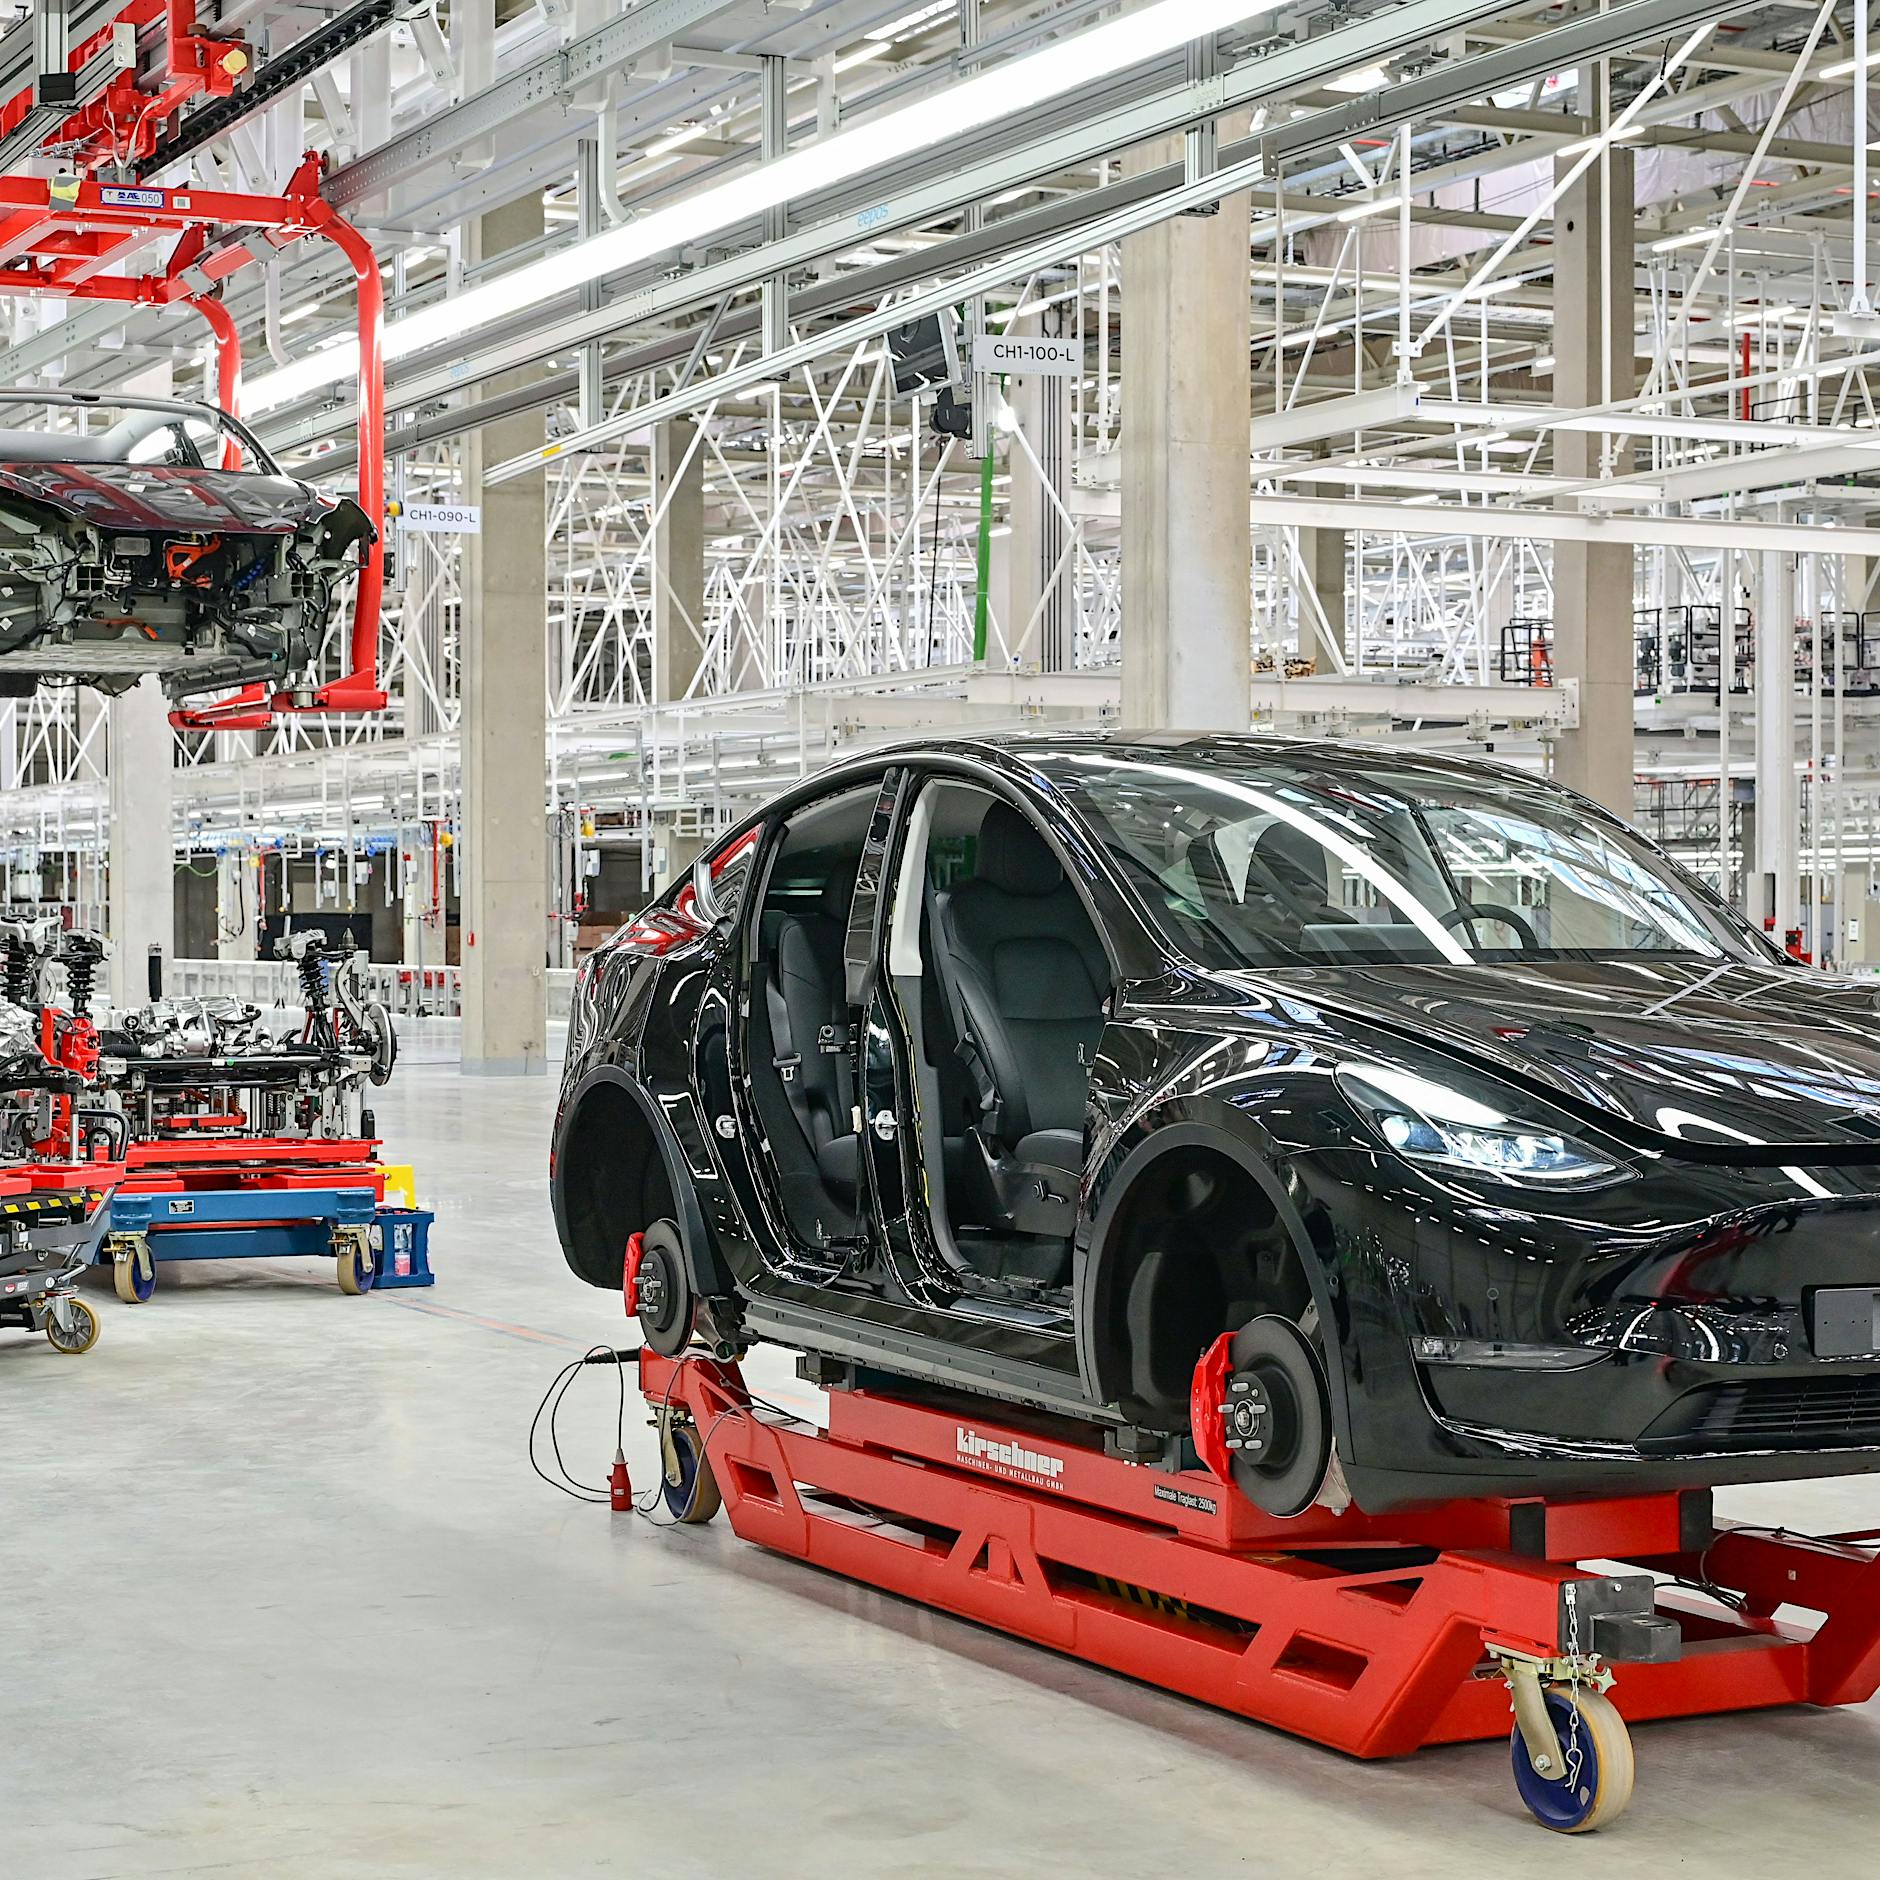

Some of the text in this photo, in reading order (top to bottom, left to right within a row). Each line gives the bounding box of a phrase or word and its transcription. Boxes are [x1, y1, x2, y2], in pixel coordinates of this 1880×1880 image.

[141, 193, 160, 204] 050
[993, 344, 1075, 362] CH1-100-L
[409, 509, 477, 523] CH1-090-L
[956, 1426, 1064, 1478] kirschner
[956, 1454, 1064, 1491] MASCHINEN- UND METALLBAU GMBH
[1154, 1484, 1177, 1502] Maximale
[1198, 1497, 1217, 1515] 2500kg
